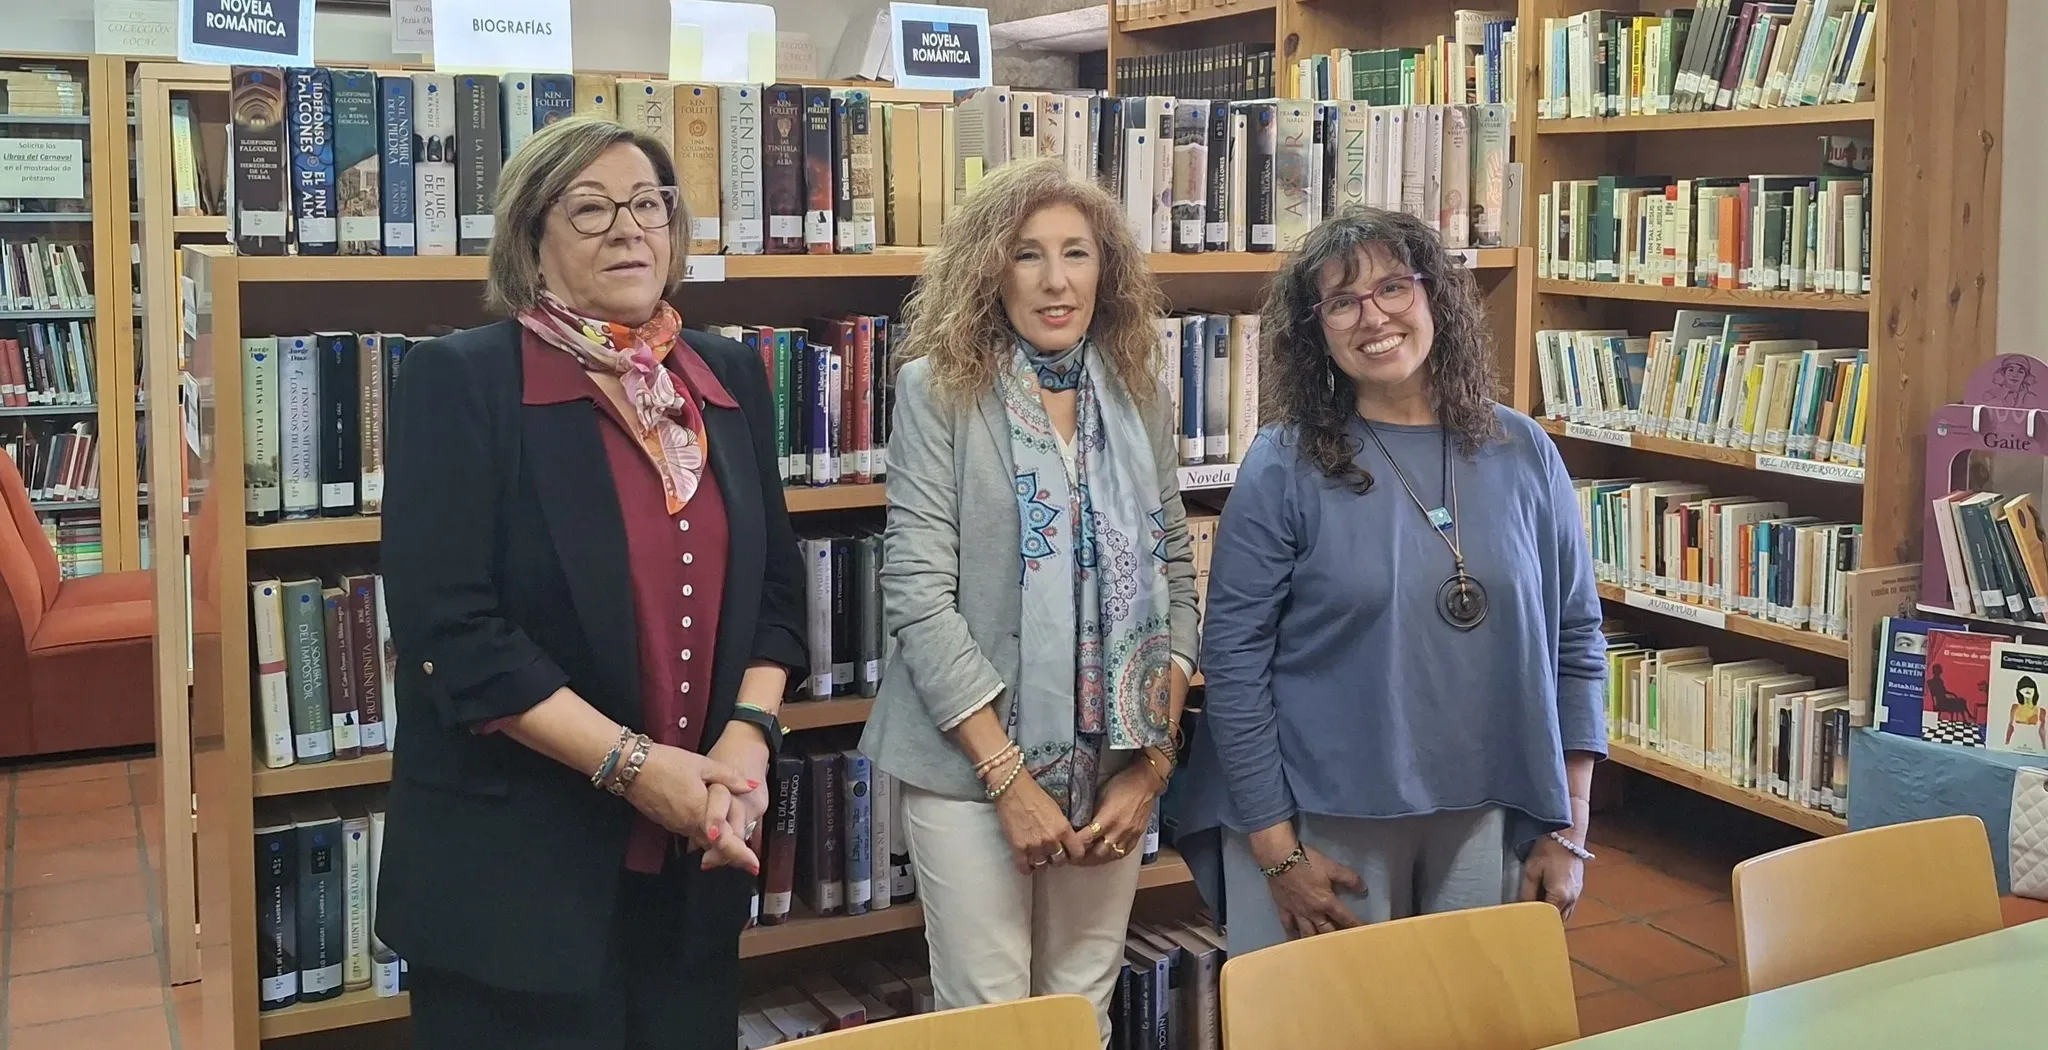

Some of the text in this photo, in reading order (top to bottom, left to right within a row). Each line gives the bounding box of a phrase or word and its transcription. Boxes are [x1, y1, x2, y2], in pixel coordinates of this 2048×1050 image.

[206, 12, 287, 37] ROMÁNTICA
[220, 0, 275, 18] NOVELA
[108, 22, 171, 34] COLECCIÓN
[472, 18, 553, 36] BIOGRAFÍAS
[922, 33, 960, 48] NOVELA
[912, 45, 971, 64] ROMÁNTICA
[298, 75, 313, 153] FALCONES
[312, 82, 325, 146] ILDEFONSO
[535, 98, 571, 108] FOLLETT
[681, 106, 714, 114] FOLLETT
[769, 106, 799, 116] FOLLETT
[730, 115, 737, 125] EL
[40, 153, 73, 161] Carnaval
[388, 123, 398, 165] PIEDRA
[398, 118, 409, 168] NOMBRE
[730, 126, 738, 162] INVIERNO
[740, 102, 755, 220] KEN FOLLETT
[424, 174, 433, 197] DEL
[475, 139, 485, 215] LA TIERRA MAL
[302, 171, 315, 219] DE ALM
[315, 171, 328, 219] EL PINT
[434, 177, 446, 218] EL JUIC
[731, 180, 739, 211] MUNDO
[256, 366, 264, 404] CARTAS
[290, 377, 299, 394] LOS
[256, 418, 264, 460] PALACIO
[1570, 425, 1598, 437] PADRES
[1603, 429, 1624, 441] HIJOS
[1984, 432, 2031, 451] Gaite
[1186, 471, 1231, 485] Novela
[1780, 458, 1864, 480] INTERPERSONALES
[1648, 598, 1698, 617] AUTOAYUDA
[298, 623, 314, 700] DEL IMPOSTOR
[310, 631, 323, 689] LA SOMBRA
[1889, 660, 1926, 670] CARMEN
[1889, 667, 1924, 677] MARTÍN
[362, 643, 376, 715] RUTA INFINITA
[777, 778, 789, 831] EL DÍA DEL
[787, 774, 800, 834] RELÁMPAGO
[826, 767, 836, 833] ANN BENSON
[351, 903, 360, 949] FRONTERA
[1158, 1017, 1167, 1050] NICOL
